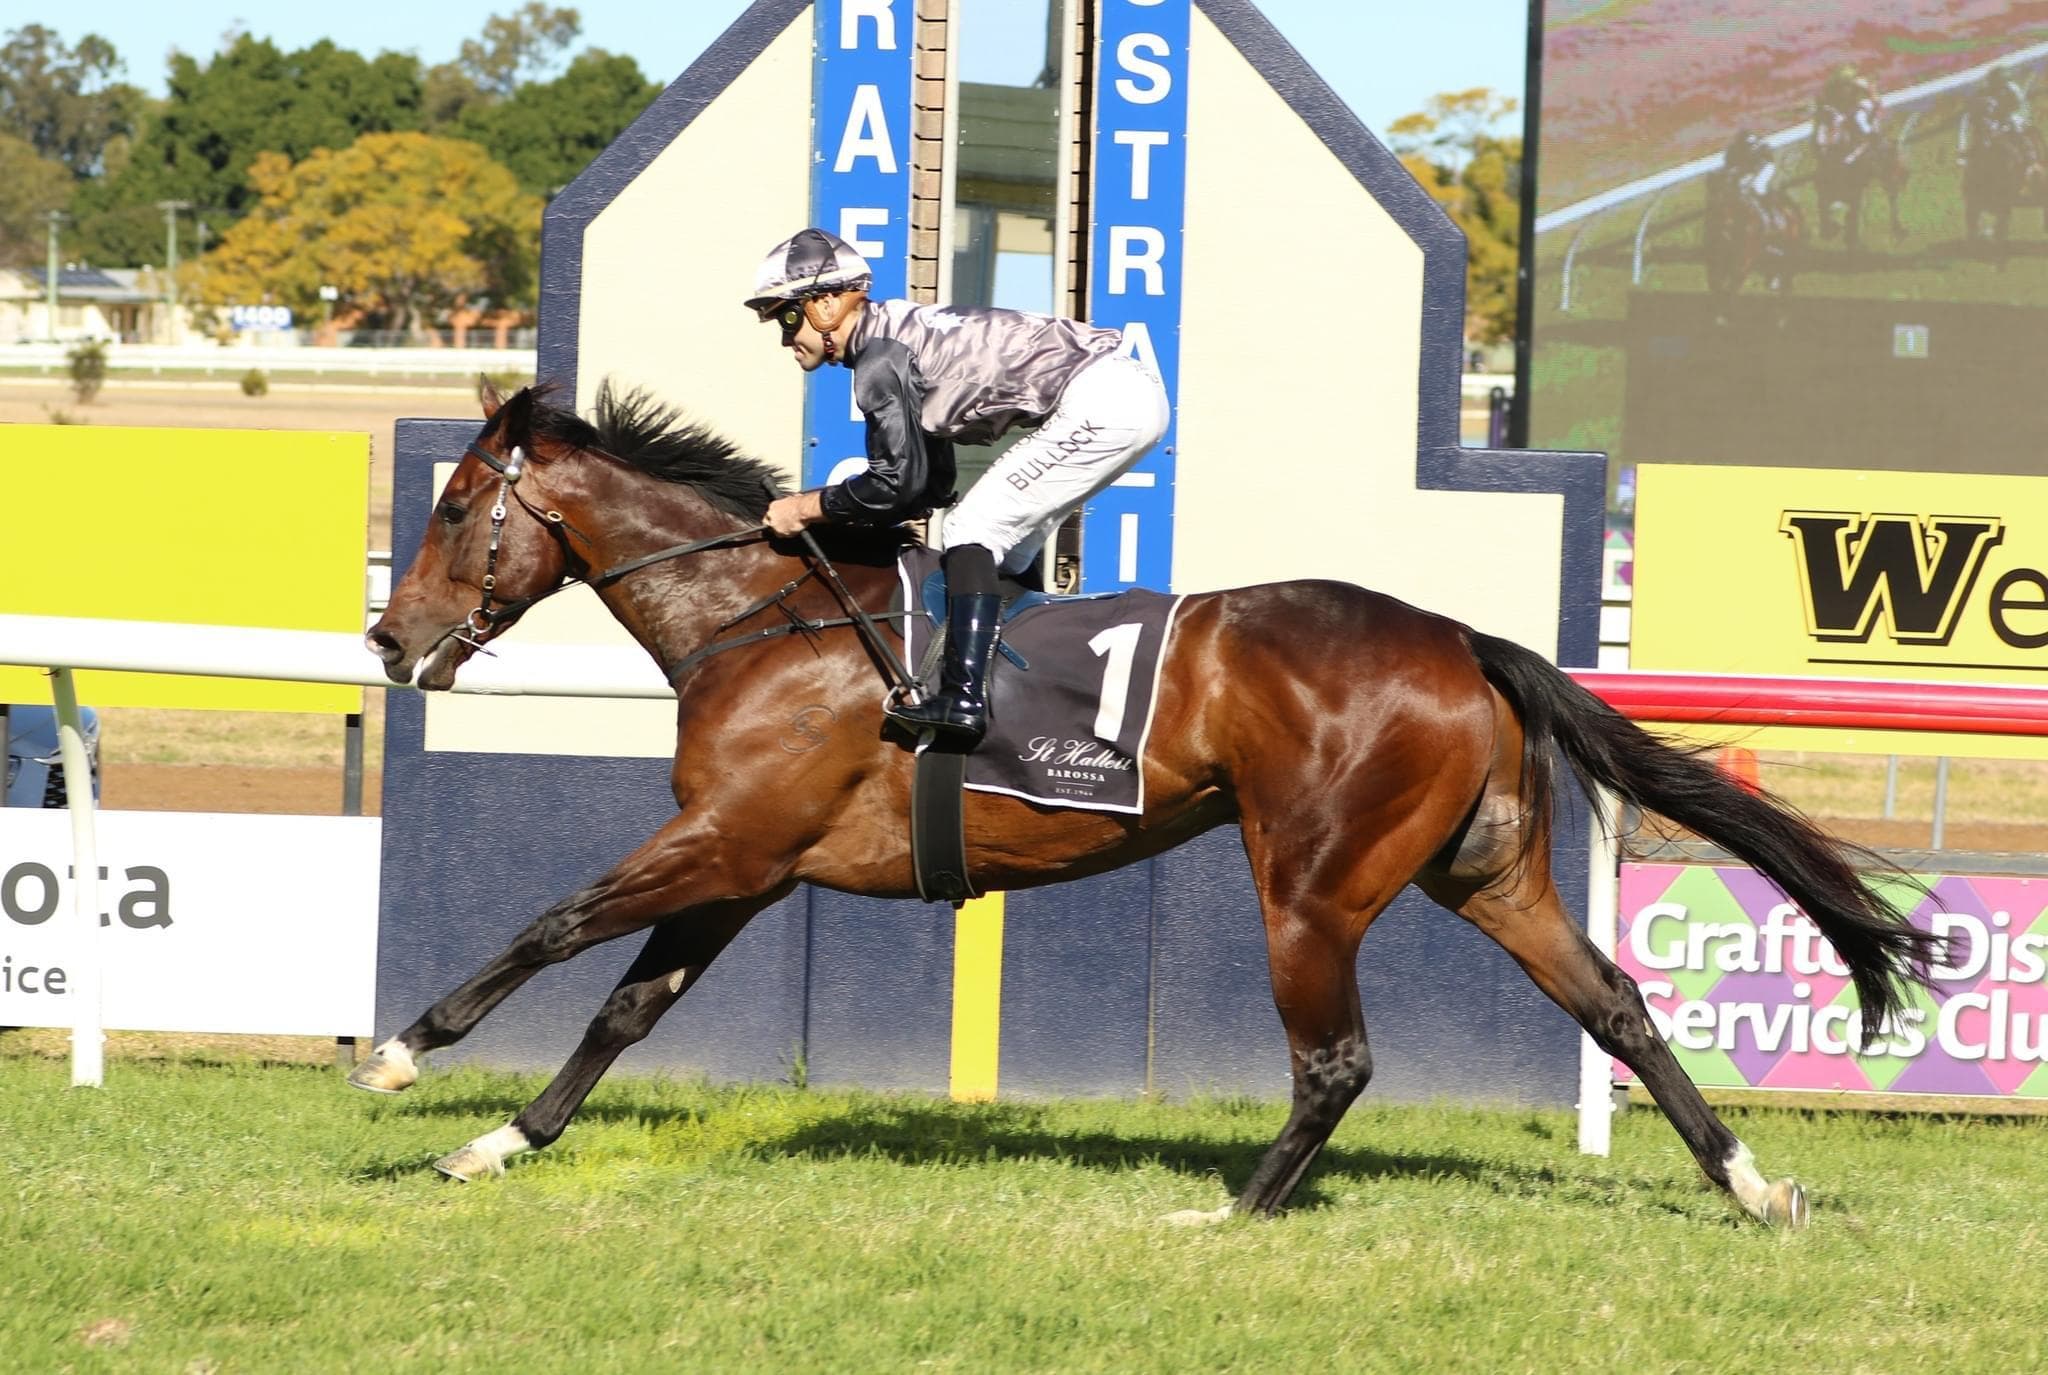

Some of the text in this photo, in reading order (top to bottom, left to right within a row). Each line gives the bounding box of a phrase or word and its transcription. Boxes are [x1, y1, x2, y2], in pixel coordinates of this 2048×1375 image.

[1107, 0, 1172, 583] STRAI
[1007, 420, 1105, 491] BULLOCK
[1779, 510, 2048, 649] We
[1088, 623, 1143, 742] 1
[1018, 736, 1058, 762] St
[1047, 768, 1105, 782] BAROSSA
